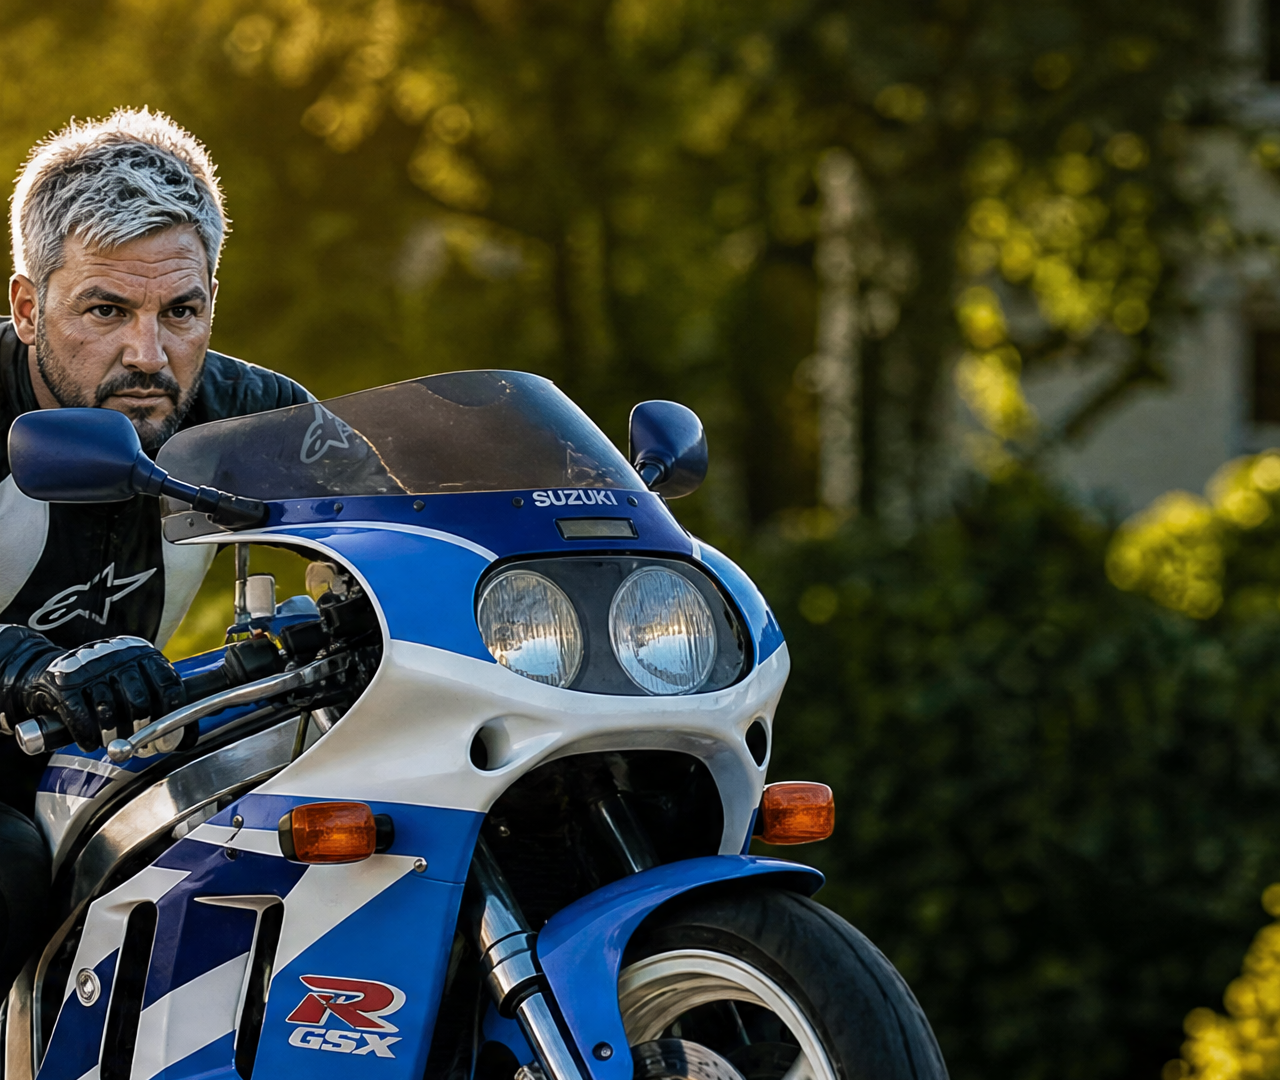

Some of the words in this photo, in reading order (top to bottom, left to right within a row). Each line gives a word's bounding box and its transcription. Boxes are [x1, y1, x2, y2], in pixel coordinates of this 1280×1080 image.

[532, 489, 618, 507] SUZUKI
[285, 974, 407, 1034] R
[288, 1026, 403, 1059] GSX
